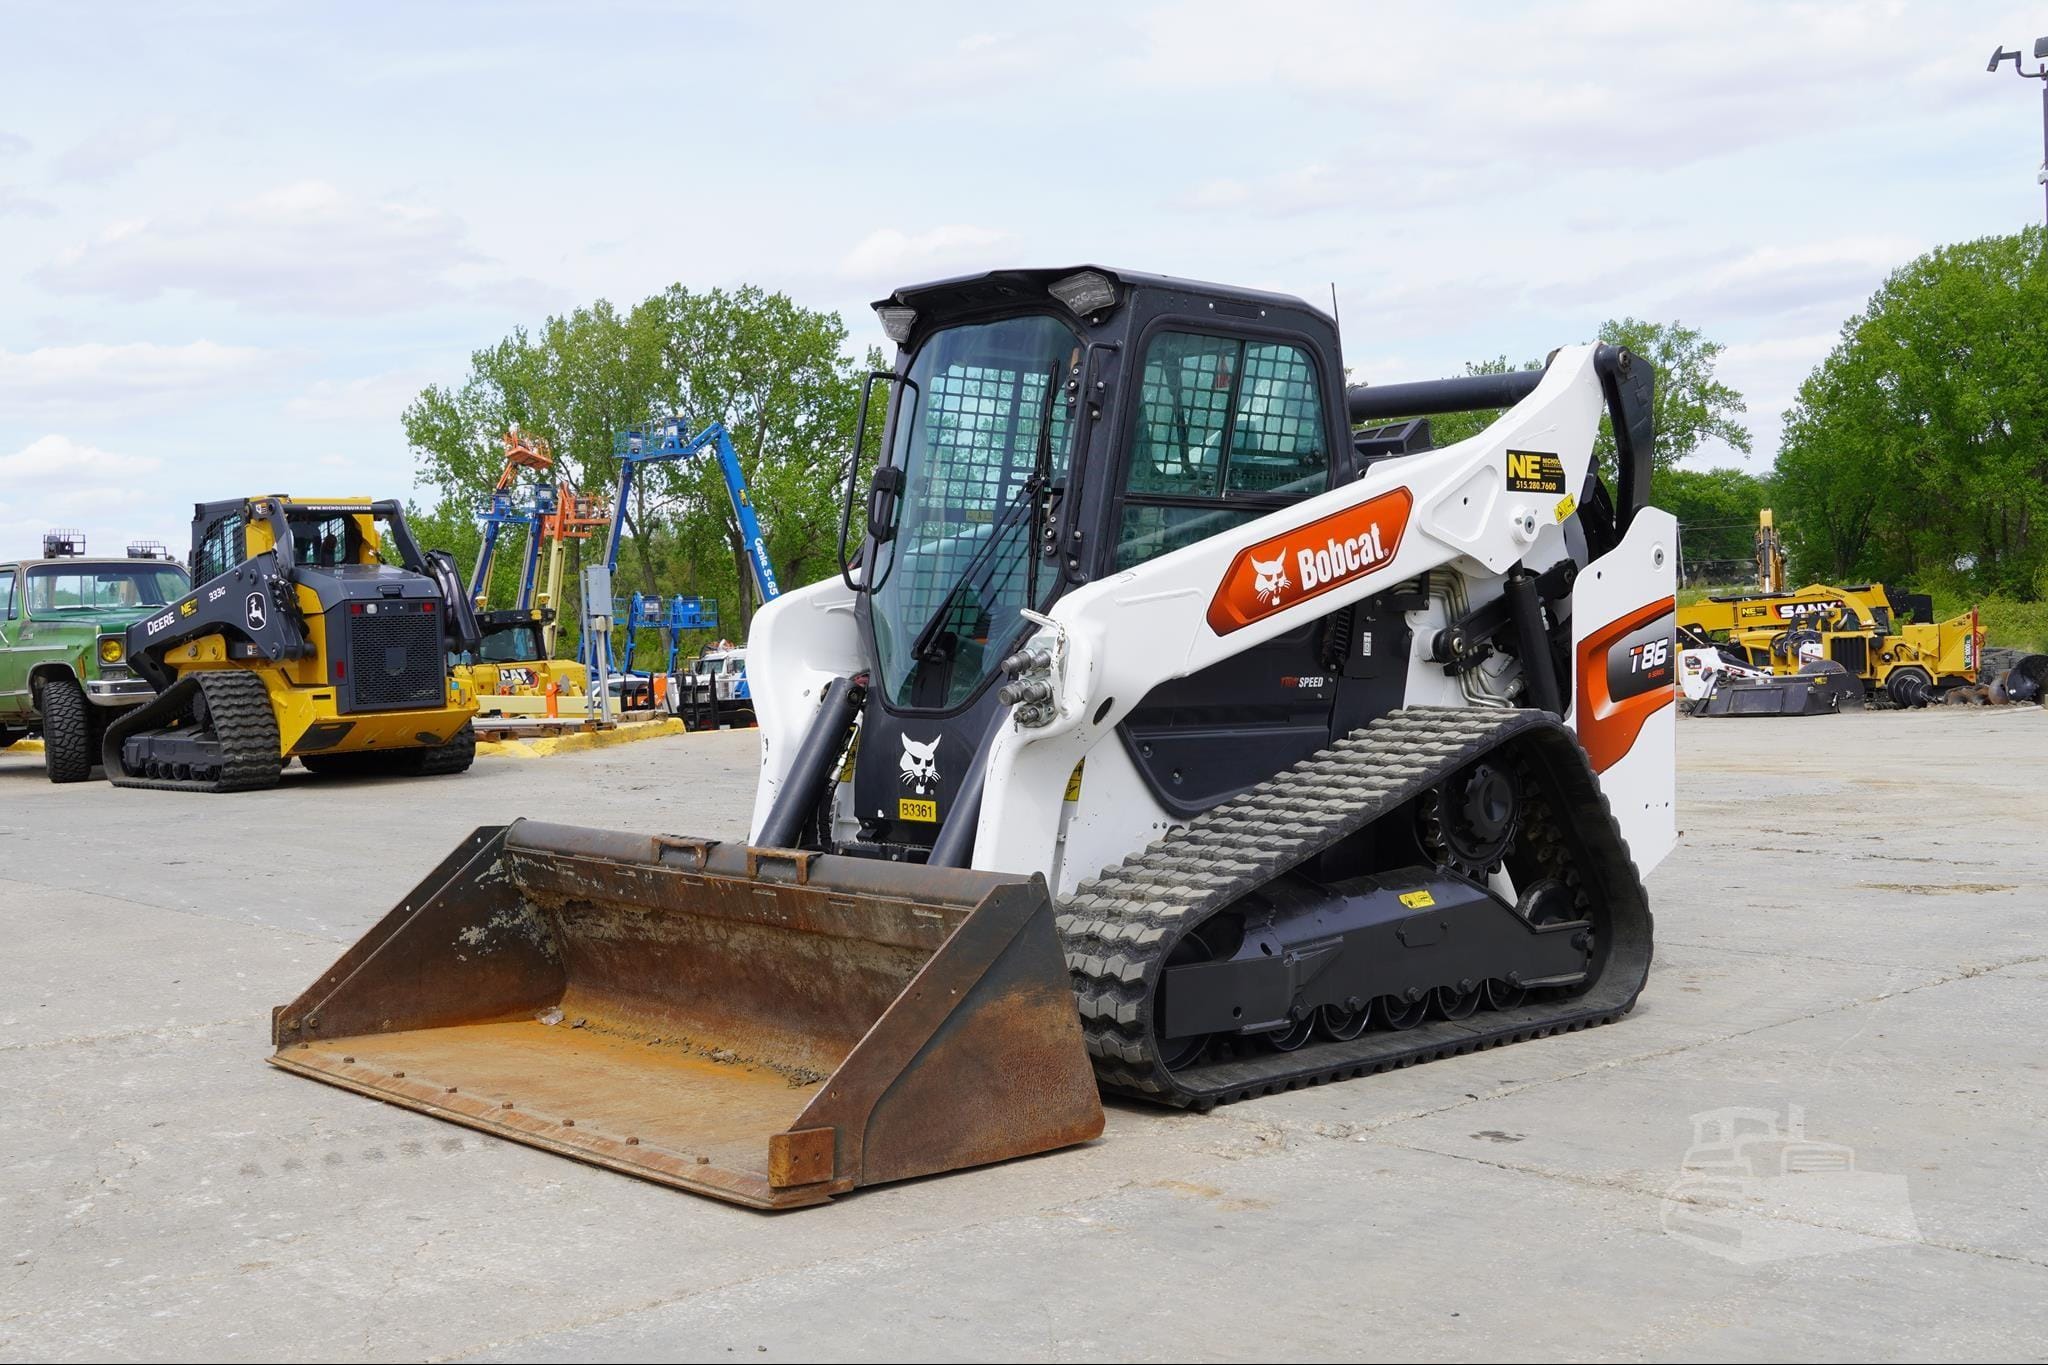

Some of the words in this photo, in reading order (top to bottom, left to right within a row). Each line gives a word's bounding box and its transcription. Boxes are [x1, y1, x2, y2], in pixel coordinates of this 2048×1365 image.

[1508, 453, 1541, 479] NE
[1515, 480, 1557, 490] 515.280.7600
[754, 537, 768, 568] Genie
[763, 568, 779, 596] S-65
[1297, 522, 1384, 591] Bobcat
[208, 586, 226, 602] 333G
[147, 611, 175, 636] DEERE
[1629, 638, 1669, 674] T86
[500, 668, 529, 684] CAT
[1298, 676, 1324, 687] SPEED
[901, 802, 932, 818] B3361
